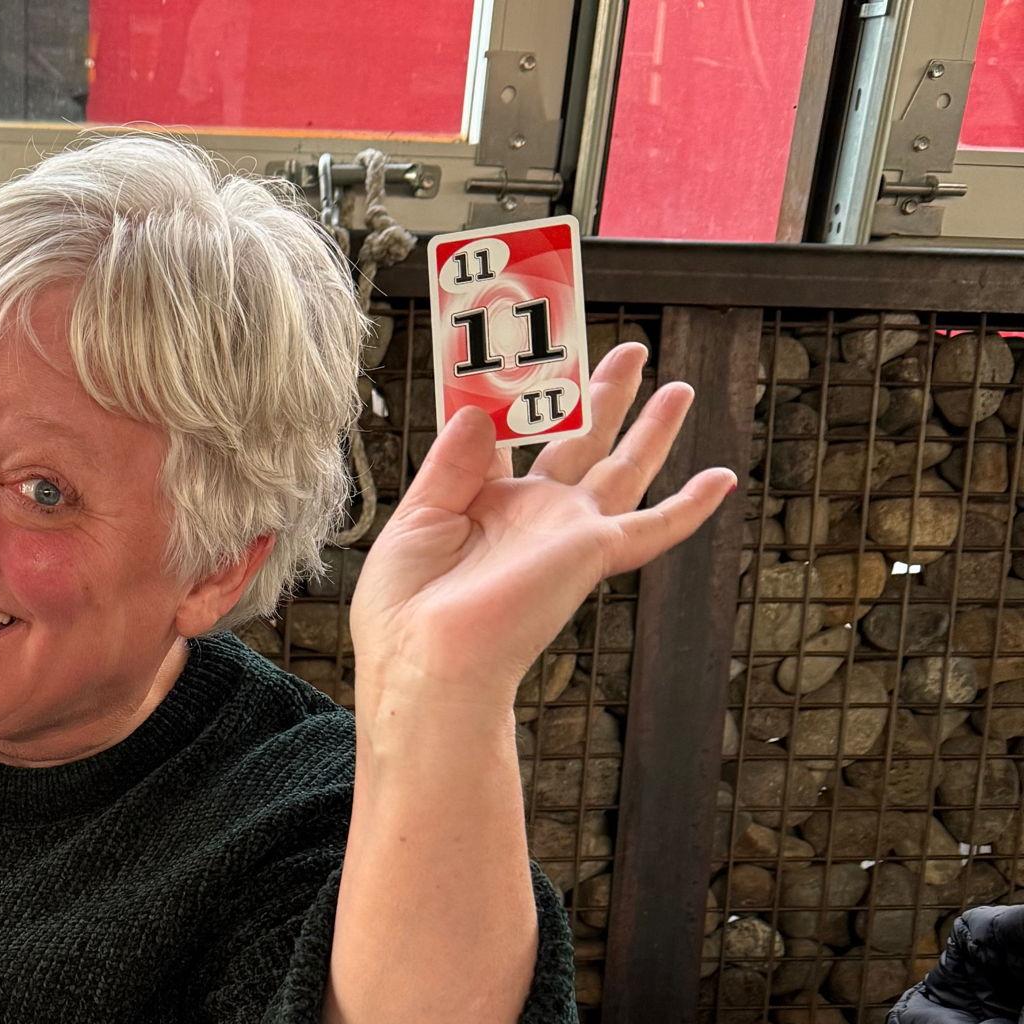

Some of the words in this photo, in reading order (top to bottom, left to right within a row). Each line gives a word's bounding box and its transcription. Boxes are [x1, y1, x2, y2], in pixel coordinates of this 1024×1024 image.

[453, 249, 495, 284] 11
[451, 296, 567, 377] 11
[522, 387, 564, 424] 11
